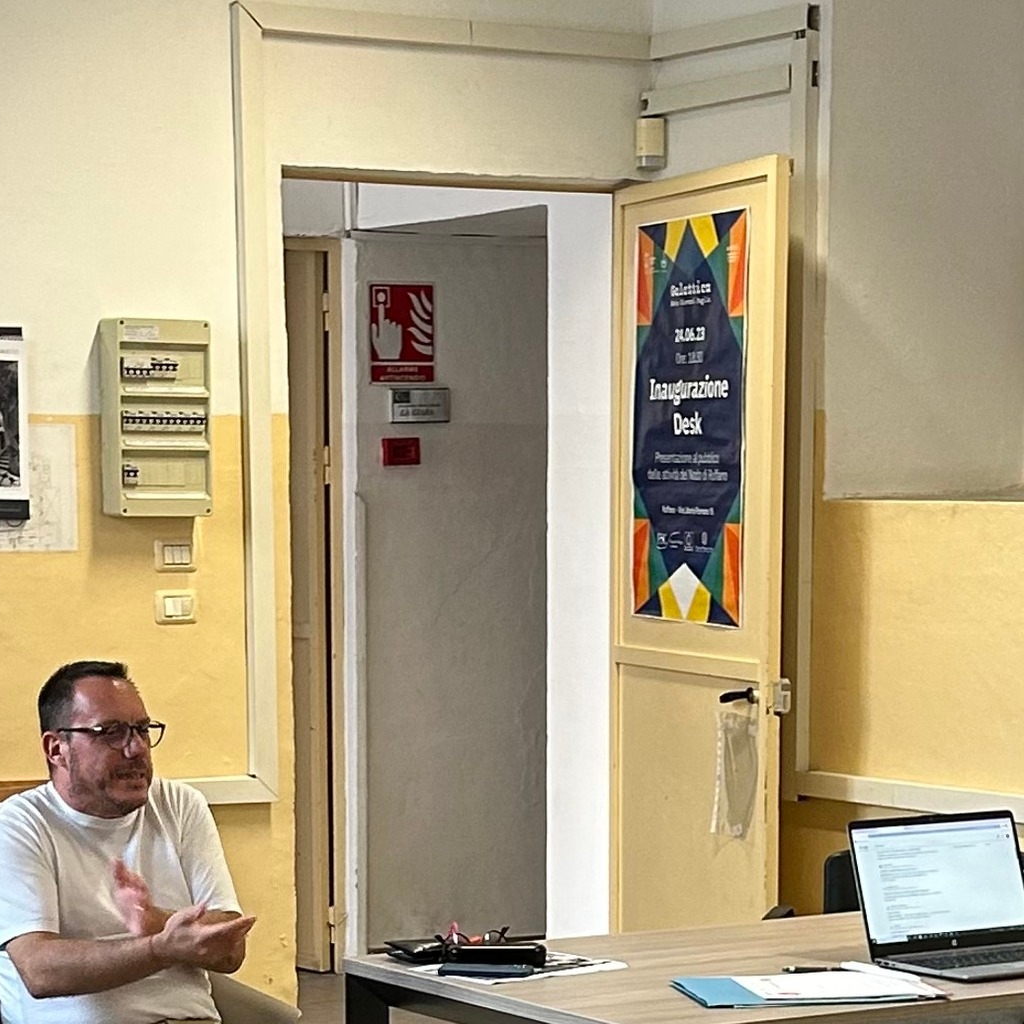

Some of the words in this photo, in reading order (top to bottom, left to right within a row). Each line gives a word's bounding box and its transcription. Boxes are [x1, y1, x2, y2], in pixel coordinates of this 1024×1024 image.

[674, 326, 706, 343] 24.06.23
[649, 374, 729, 406] Inaugurazione
[673, 410, 703, 436] Desk
